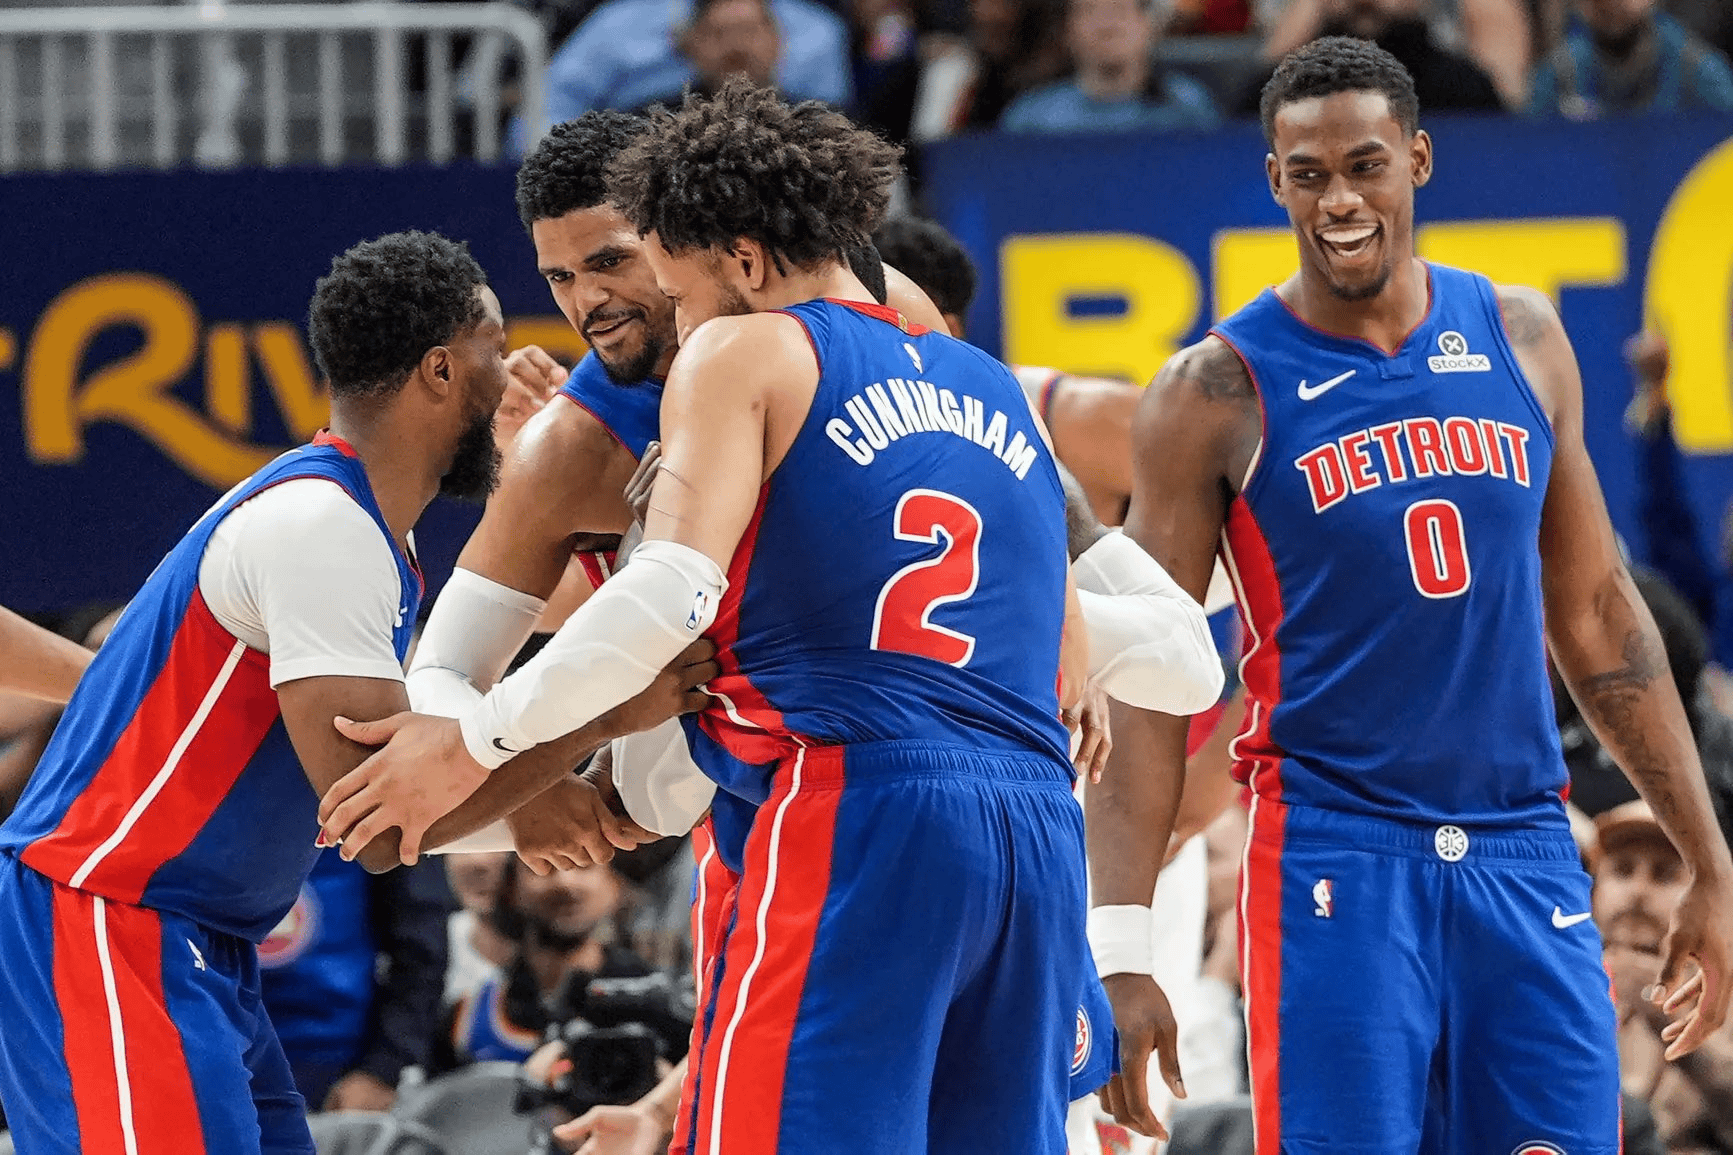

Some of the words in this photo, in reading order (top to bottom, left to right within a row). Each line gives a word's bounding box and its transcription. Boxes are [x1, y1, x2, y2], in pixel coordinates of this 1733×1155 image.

[1431, 356, 1488, 370] StockX
[825, 378, 1037, 480] CUNNINGHAM
[1294, 416, 1530, 514] DETROIT
[870, 488, 983, 668] 2
[1404, 499, 1471, 599] 0
